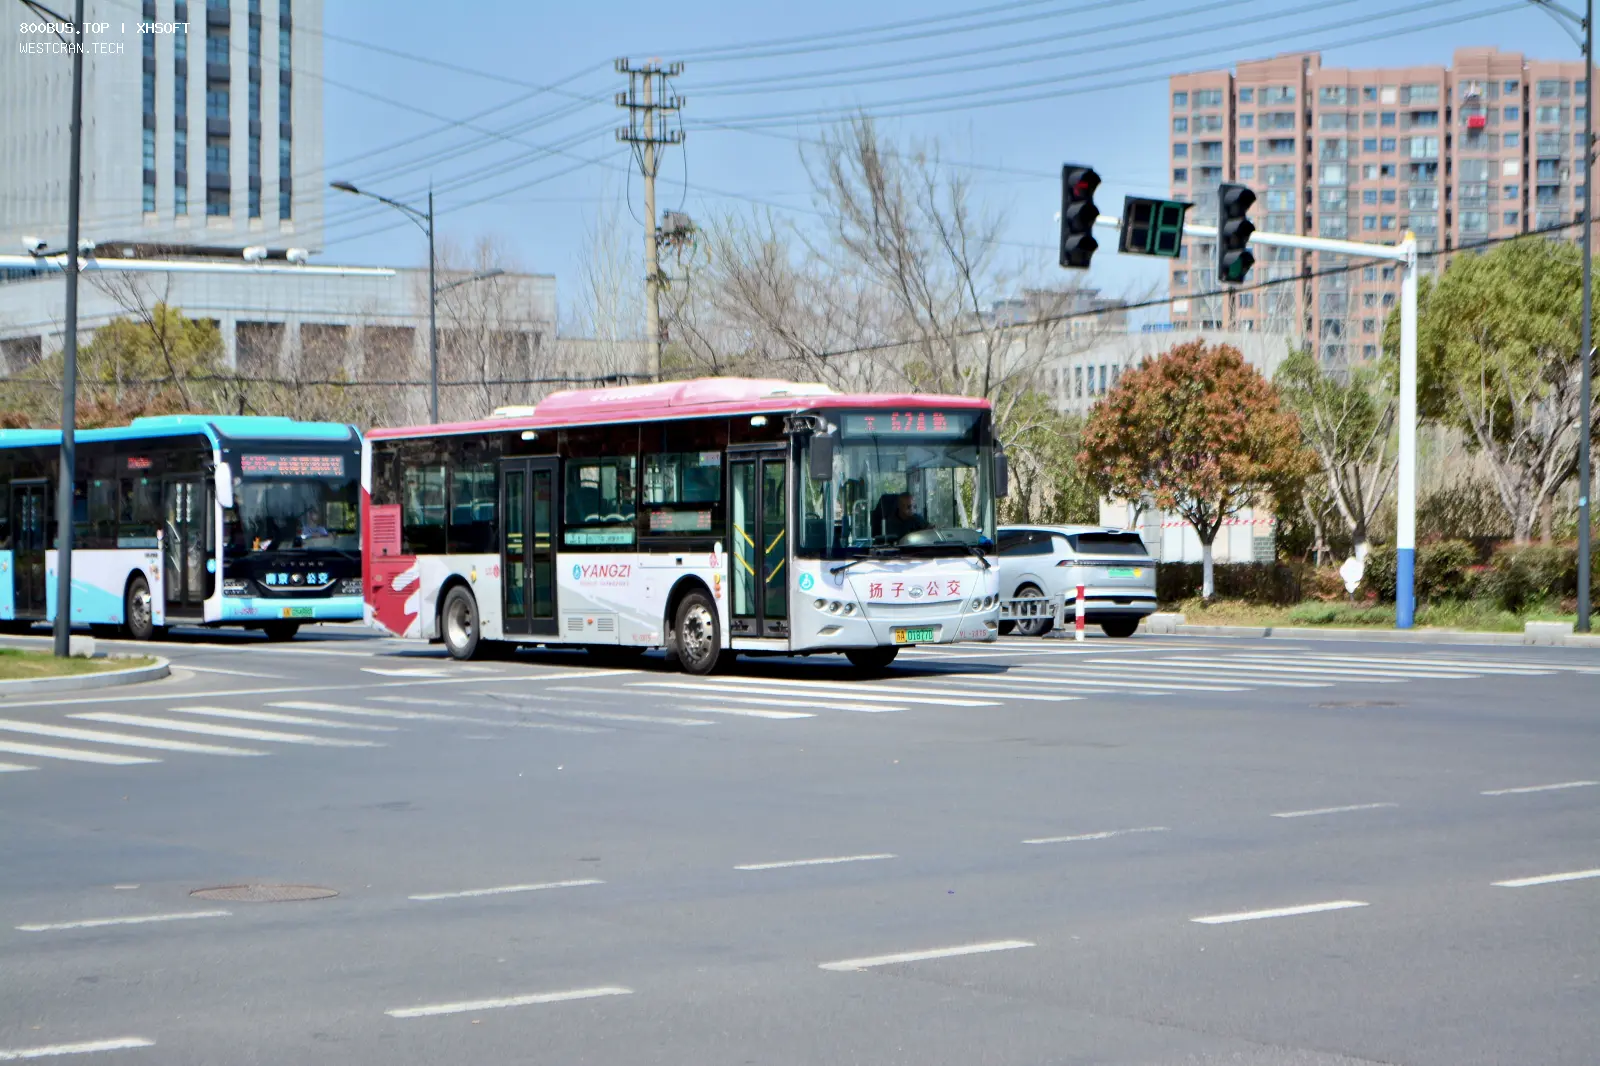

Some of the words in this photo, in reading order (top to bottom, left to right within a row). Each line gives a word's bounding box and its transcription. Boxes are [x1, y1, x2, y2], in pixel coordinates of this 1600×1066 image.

[581, 564, 631, 578] YANGZI
[869, 582, 904, 598] 扬子
[926, 580, 961, 597] 公交
